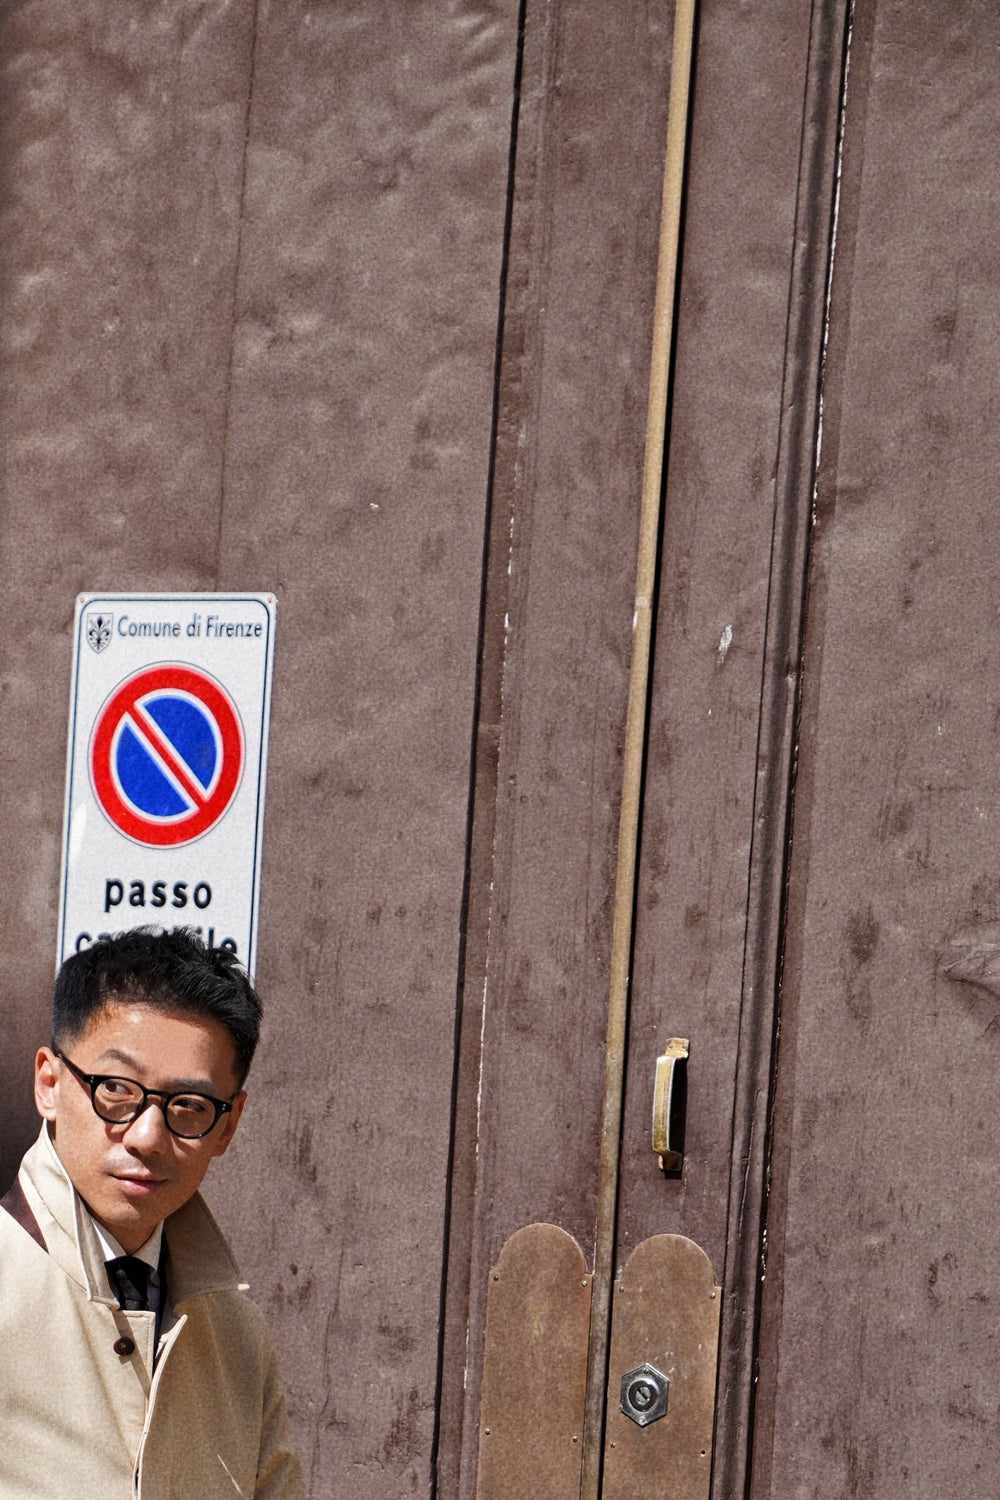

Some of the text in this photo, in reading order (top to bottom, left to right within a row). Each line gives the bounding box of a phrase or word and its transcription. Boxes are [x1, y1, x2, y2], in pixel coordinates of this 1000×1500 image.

[117, 613, 263, 637] Comune di Firenze
[105, 878, 212, 913] passo
